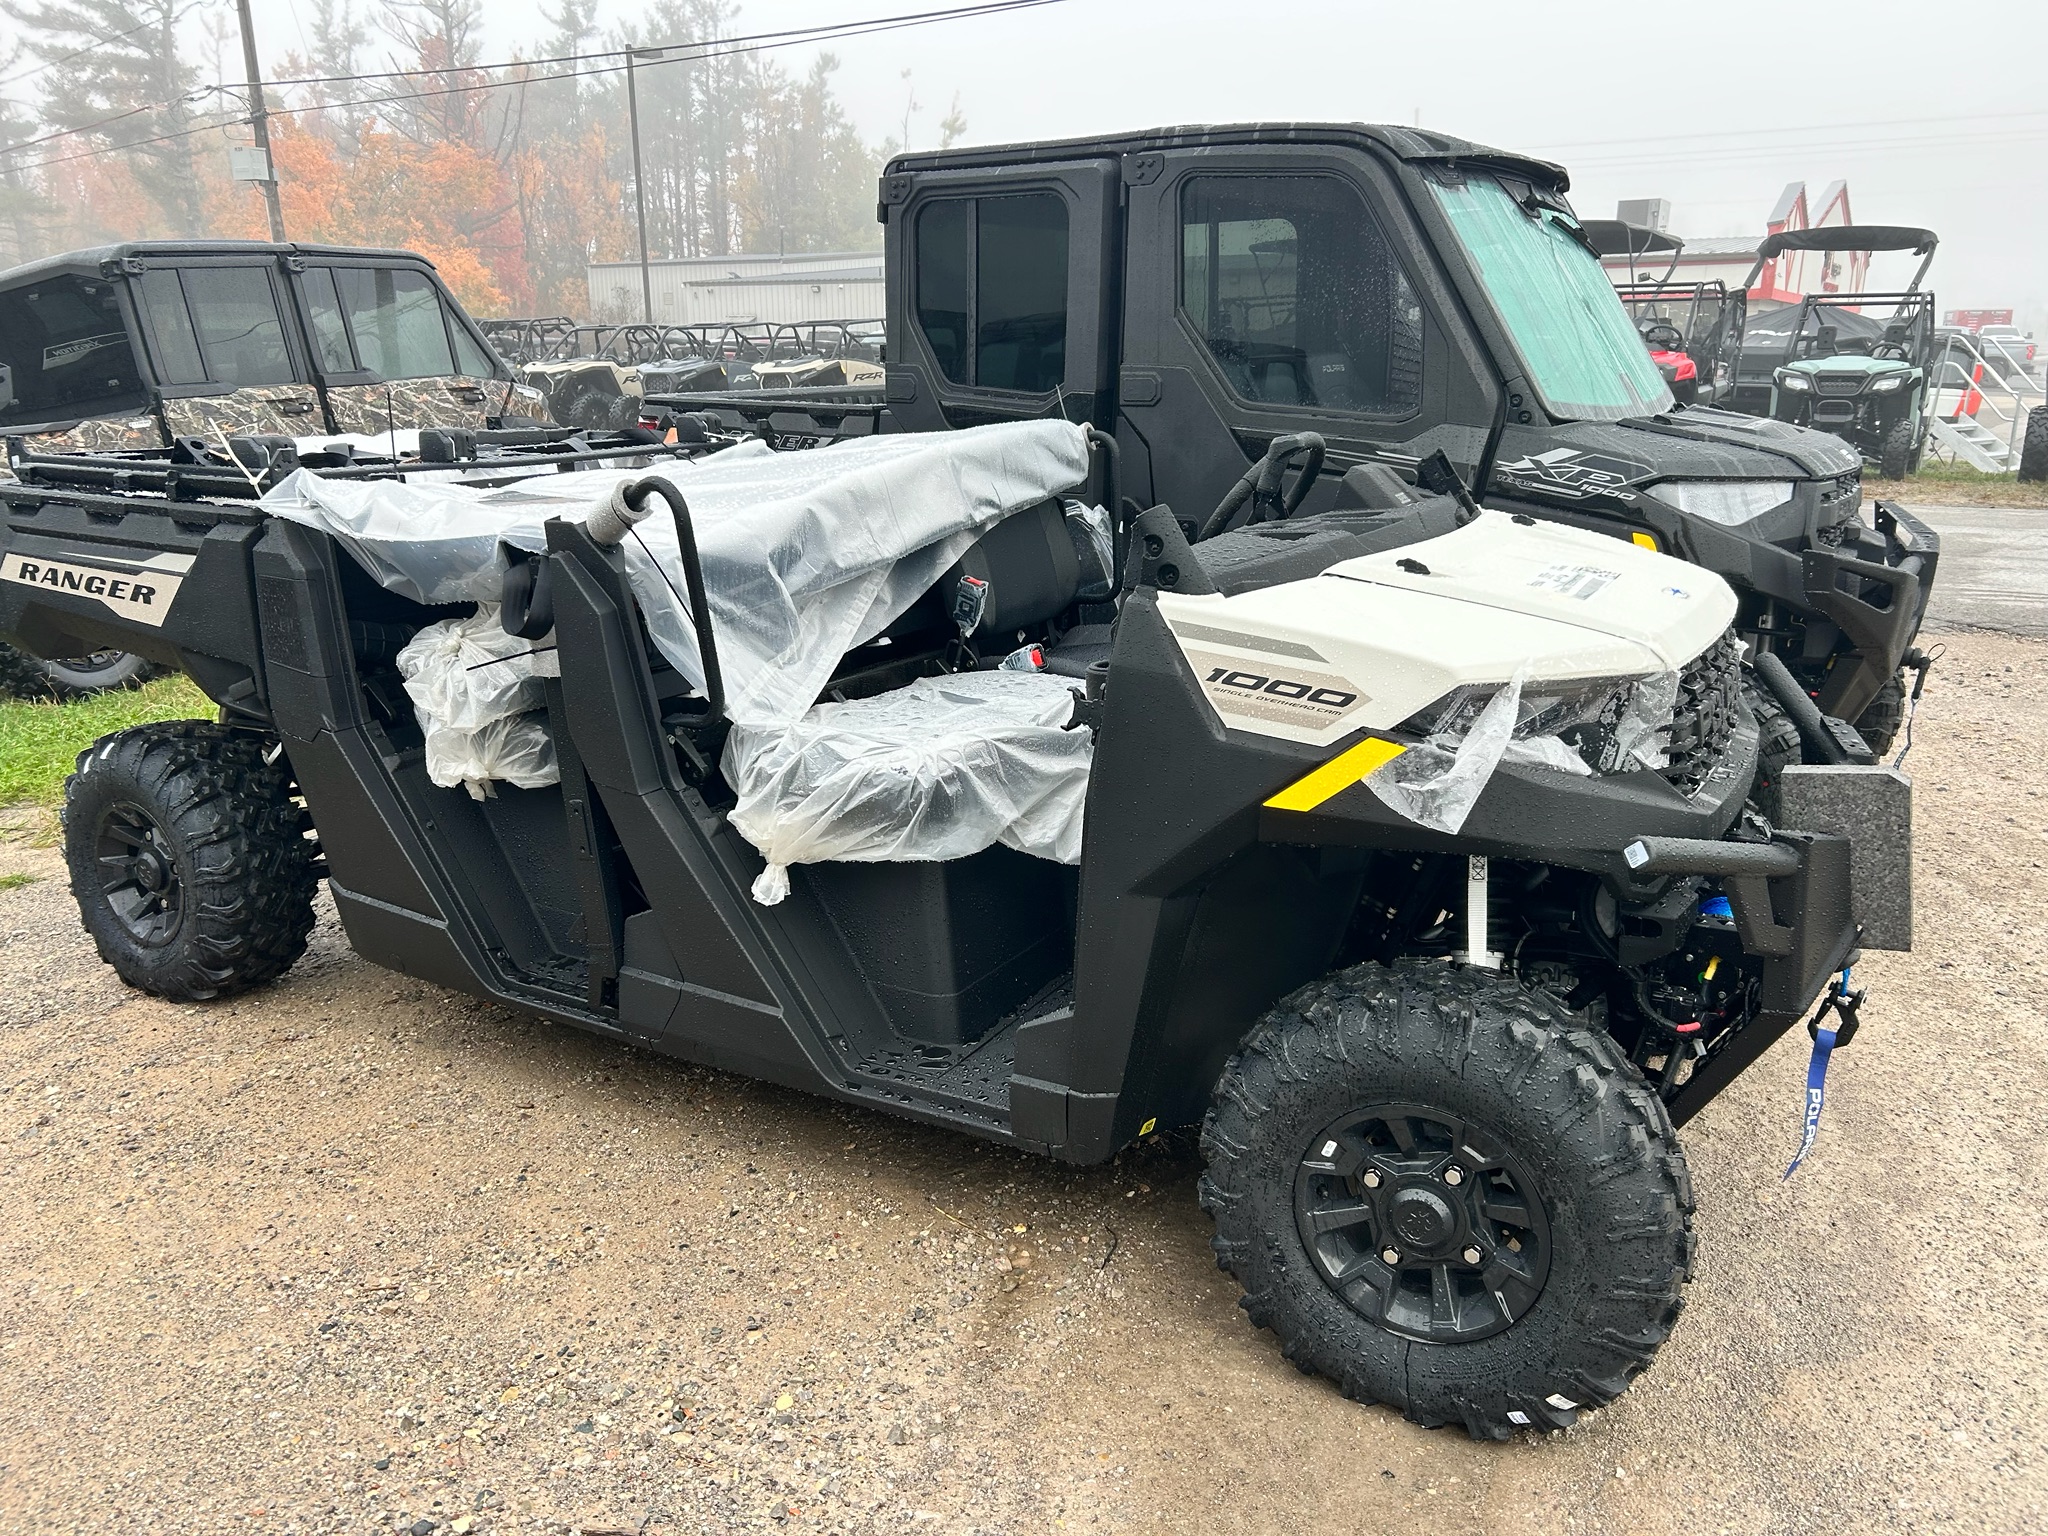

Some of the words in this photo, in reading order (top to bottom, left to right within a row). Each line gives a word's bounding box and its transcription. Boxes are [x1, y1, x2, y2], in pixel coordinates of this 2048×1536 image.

[733, 374, 752, 383] RZ
[852, 371, 884, 383] RZR
[1580, 483, 1637, 501] 1000
[18, 561, 157, 605] RANGER
[1206, 668, 1357, 707] 1000
[1212, 686, 1253, 699] SINGLE
[1256, 693, 1316, 711] OVERHEAD
[1315, 706, 1343, 716] CAM
